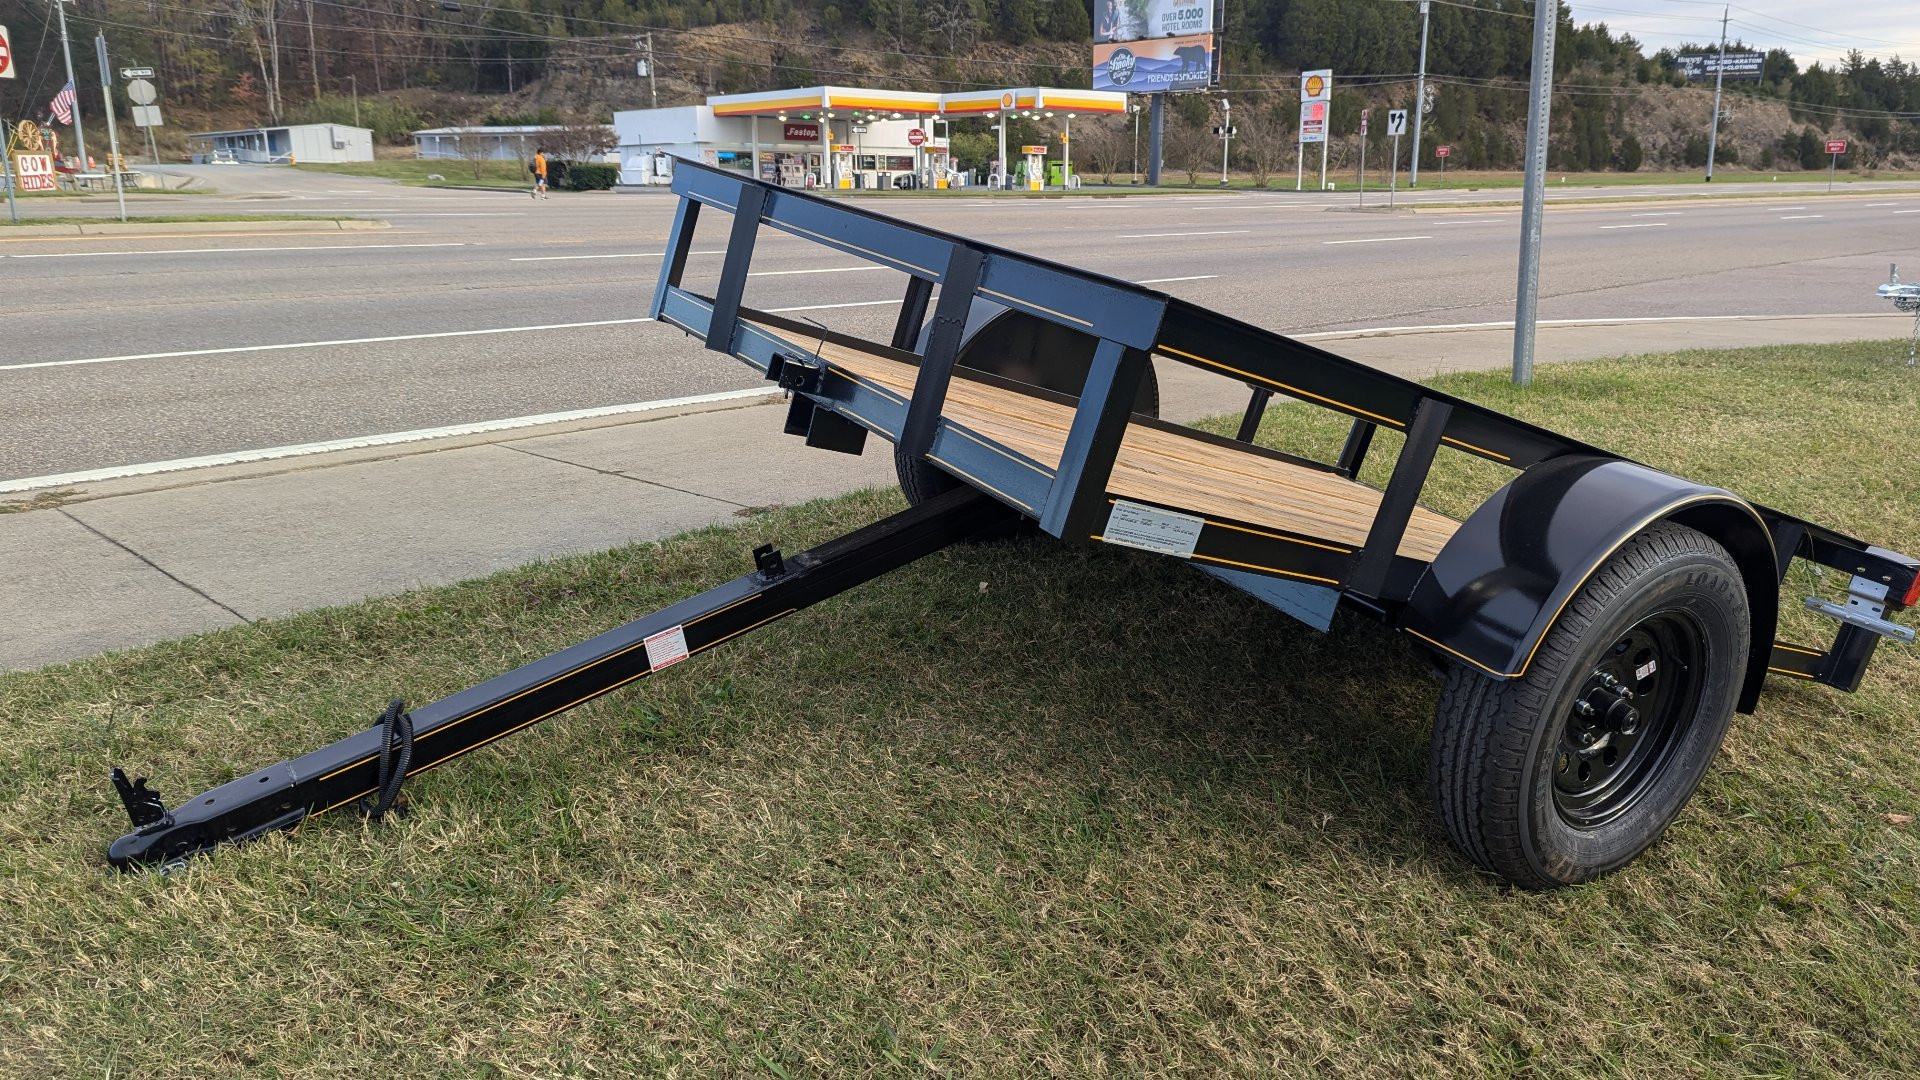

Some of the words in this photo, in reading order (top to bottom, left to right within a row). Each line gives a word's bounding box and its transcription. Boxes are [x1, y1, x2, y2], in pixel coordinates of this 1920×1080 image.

[1162, 13, 1176, 22] OVER
[1178, 8, 1203, 20] 5,000
[1162, 22, 1179, 32] HOTEL
[1182, 20, 1203, 30] ROOMS
[1147, 74, 1174, 83] FRIENDS
[1179, 71, 1208, 81] SMOKIES
[21, 156, 48, 172] COW
[22, 173, 55, 190] HIDES
[1685, 572, 1729, 594] LOAD
